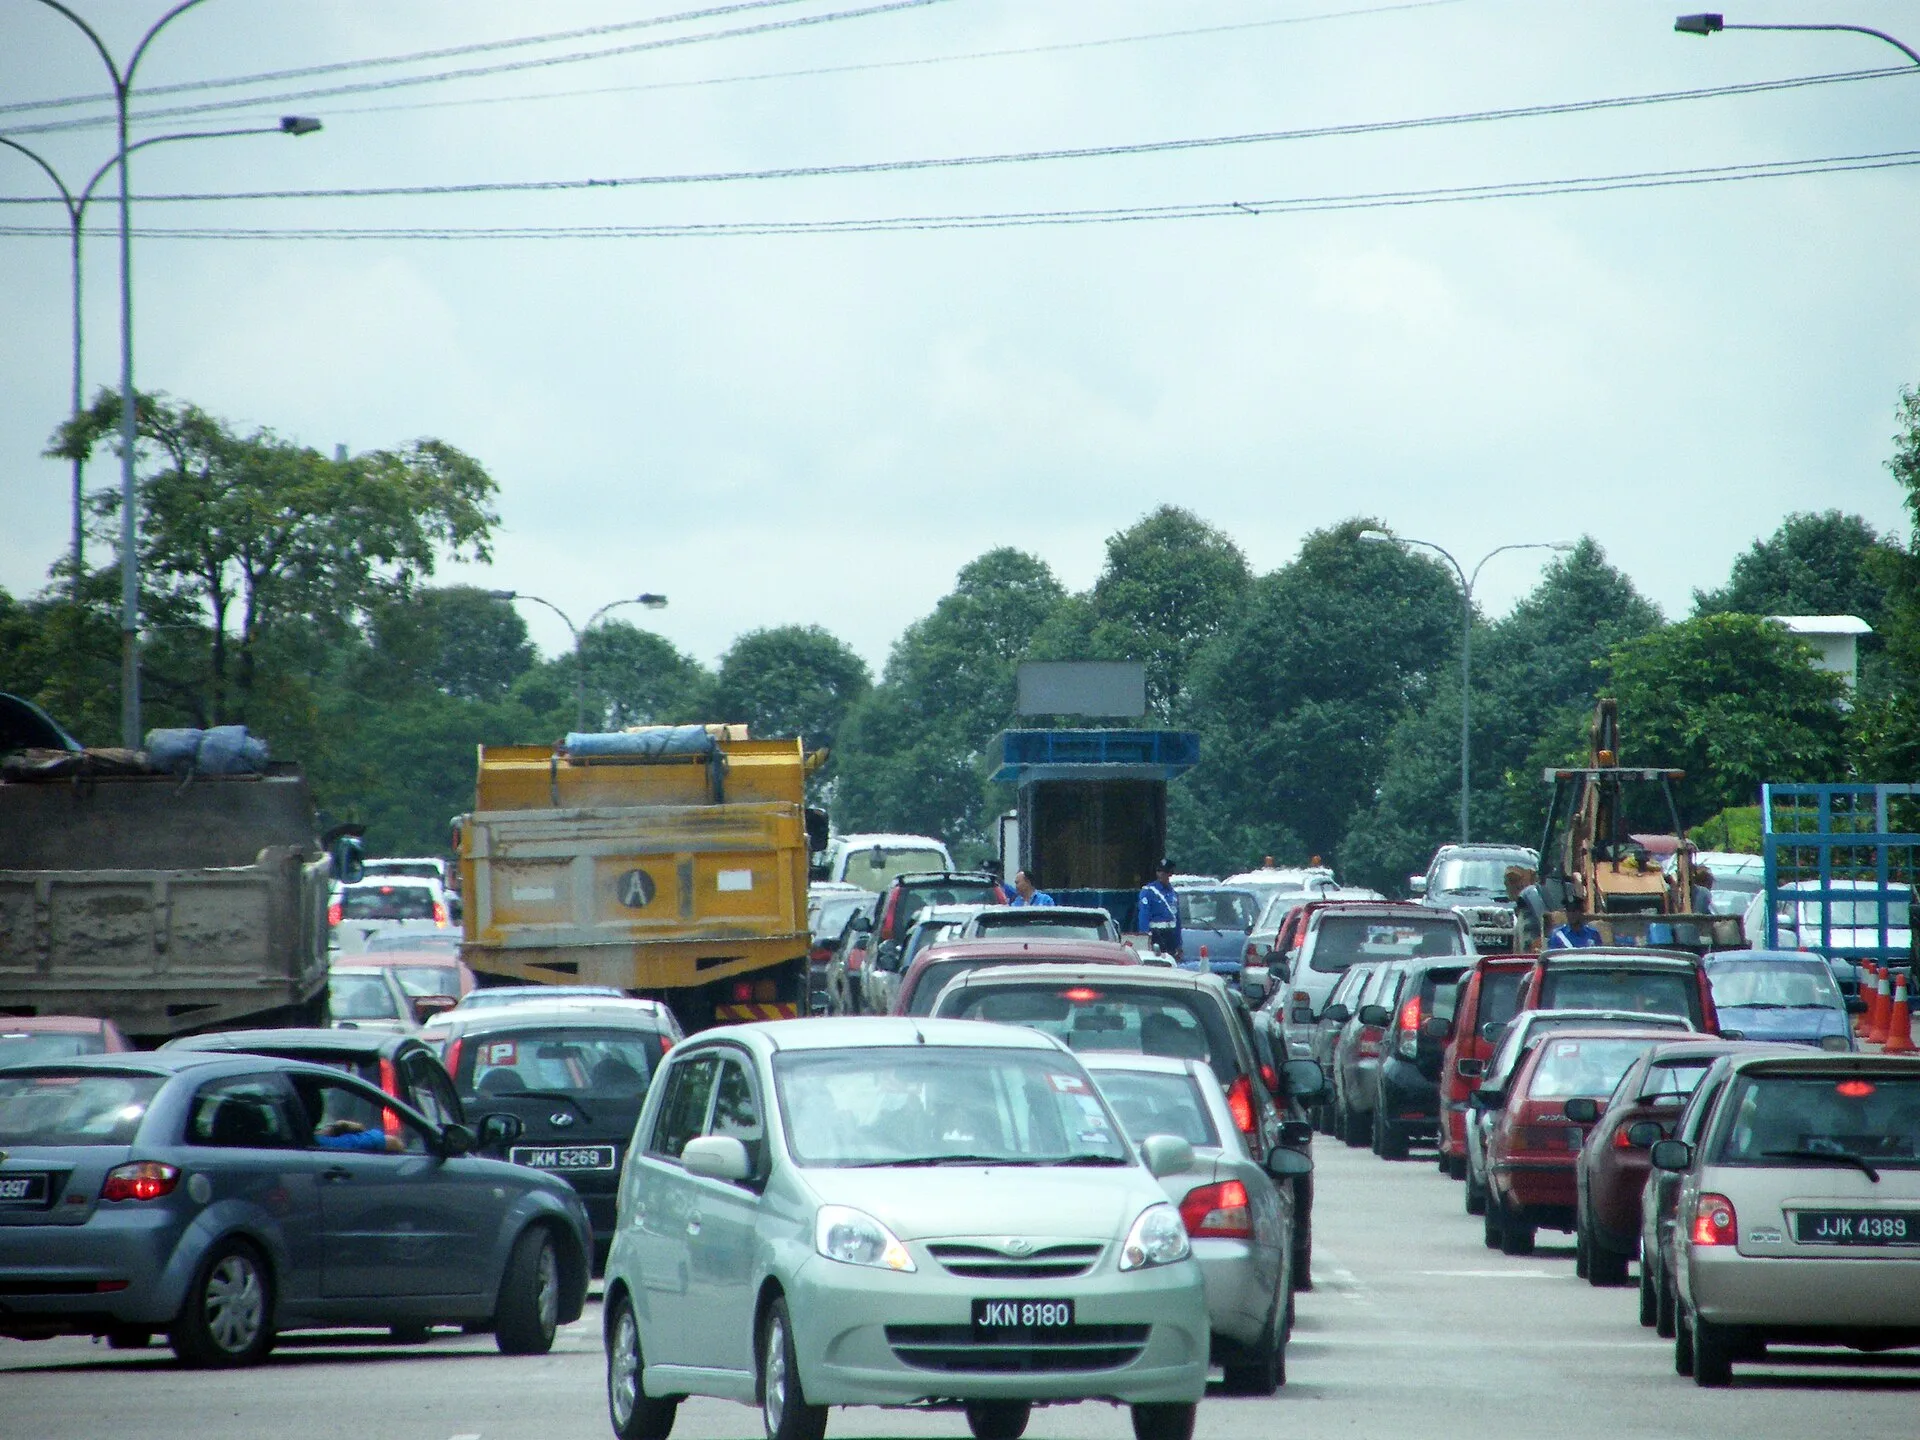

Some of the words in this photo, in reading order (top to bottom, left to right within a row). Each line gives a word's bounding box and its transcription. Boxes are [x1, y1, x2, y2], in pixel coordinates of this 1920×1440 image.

[624, 871, 648, 905] A
[490, 1043, 514, 1064] P
[1557, 1044, 1578, 1057] P
[1050, 1073, 1084, 1091] P
[559, 1150, 600, 1166] 5269
[1816, 1218, 1853, 1236] JJK
[1858, 1218, 1907, 1237] 4389
[978, 1303, 1018, 1326] JKN
[1022, 1303, 1069, 1326] 8180
